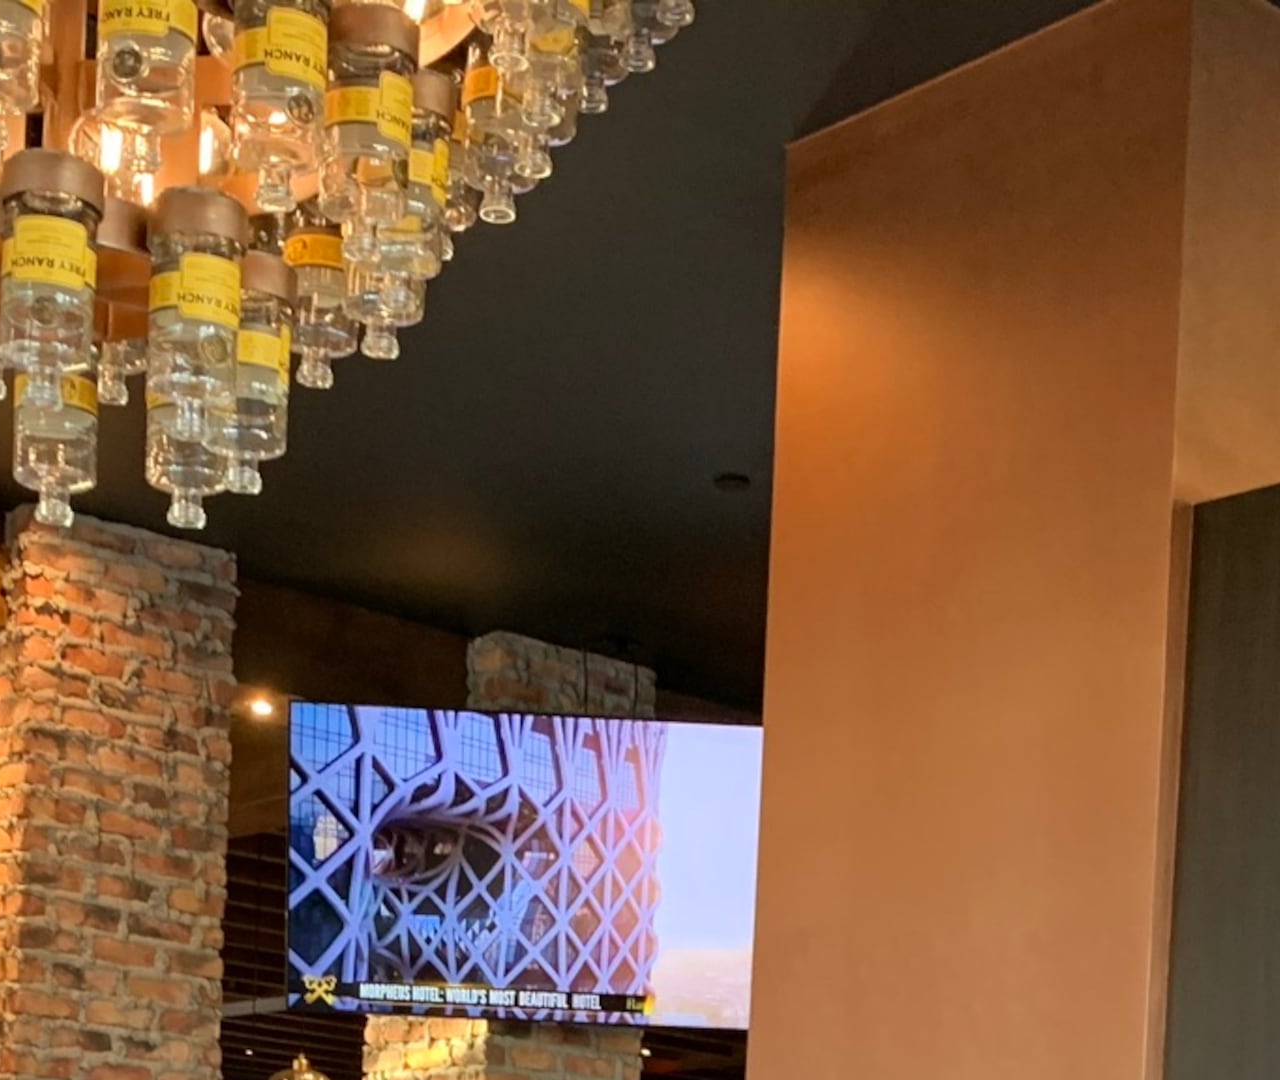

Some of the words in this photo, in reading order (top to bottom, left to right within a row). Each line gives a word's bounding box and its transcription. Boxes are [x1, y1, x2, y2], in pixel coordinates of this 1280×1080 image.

[136, 6, 170, 22] FREY
[263, 47, 311, 68] RANCH
[11, 255, 55, 269] RANCH
[60, 259, 87, 279] FREY
[176, 291, 222, 309] RANCH
[359, 983, 411, 1000] MORPHEUS
[445, 987, 487, 1004] WORLD'S
[489, 989, 516, 1006] MOST
[519, 991, 569, 1009] BEAUTIFUL
[571, 994, 602, 1010] HOTEL
